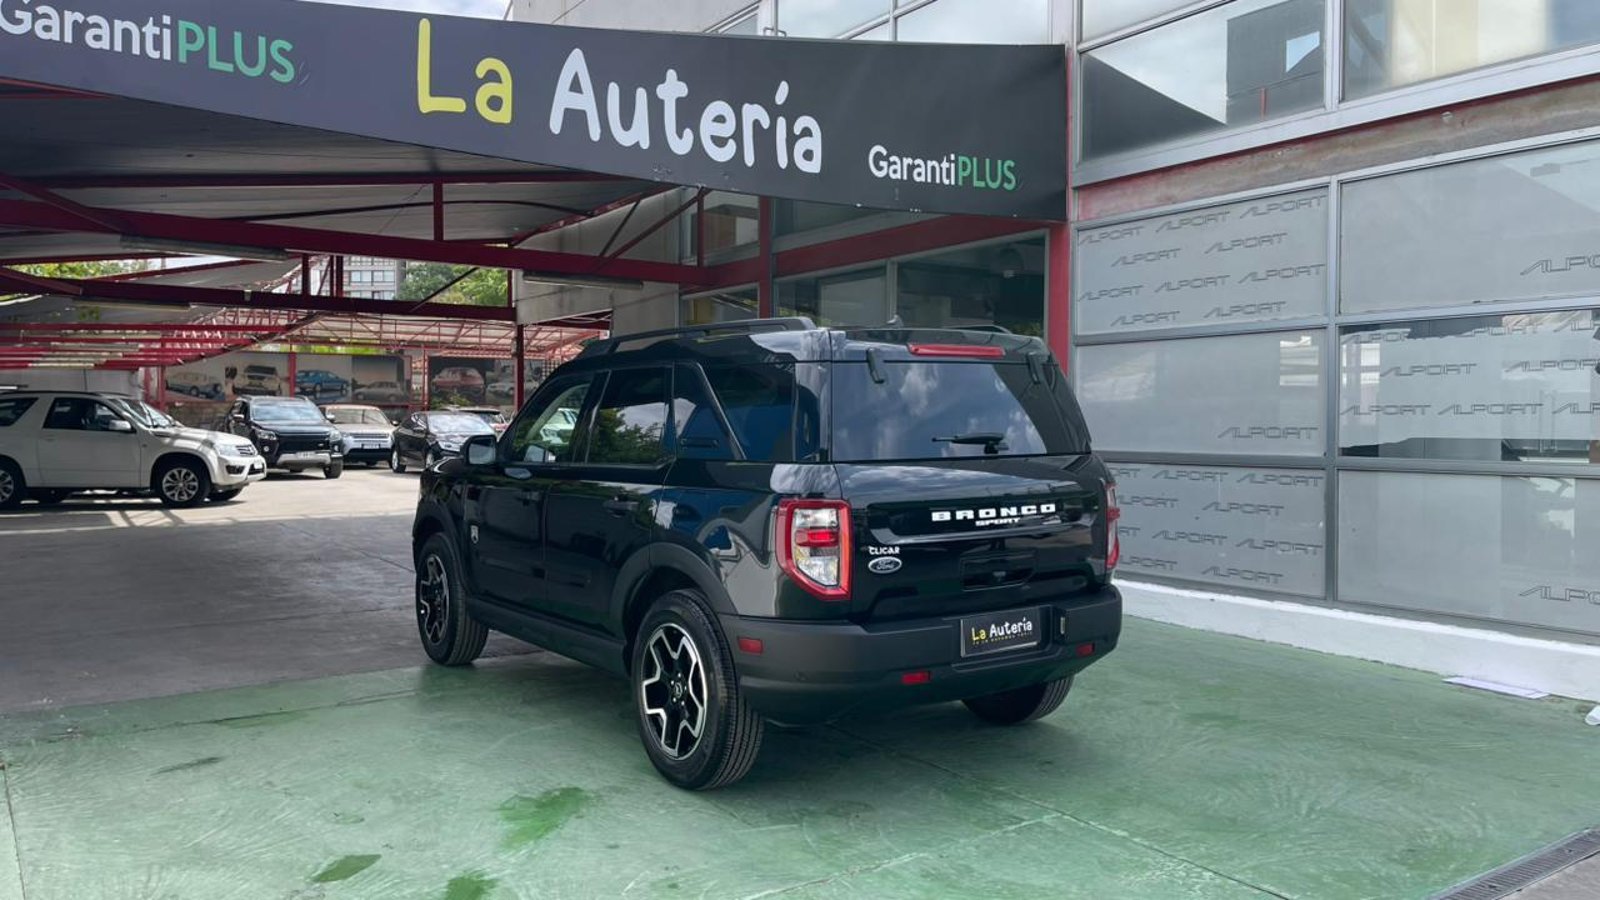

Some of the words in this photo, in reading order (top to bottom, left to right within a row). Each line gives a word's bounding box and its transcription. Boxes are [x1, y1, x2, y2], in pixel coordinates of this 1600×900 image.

[0, 0, 295, 83] GarantiPLUS
[417, 18, 513, 124] La
[549, 47, 823, 174] Autería
[868, 144, 1017, 191] GarantiPLUS
[1520, 254, 1600, 276] ALPO
[1504, 358, 1600, 373] ALPOR
[931, 503, 1056, 522] BRONCO
[975, 517, 1021, 526] SPORT
[1518, 585, 1600, 606] ALPO
[971, 627, 986, 641] La
[989, 616, 1033, 638] Autería
